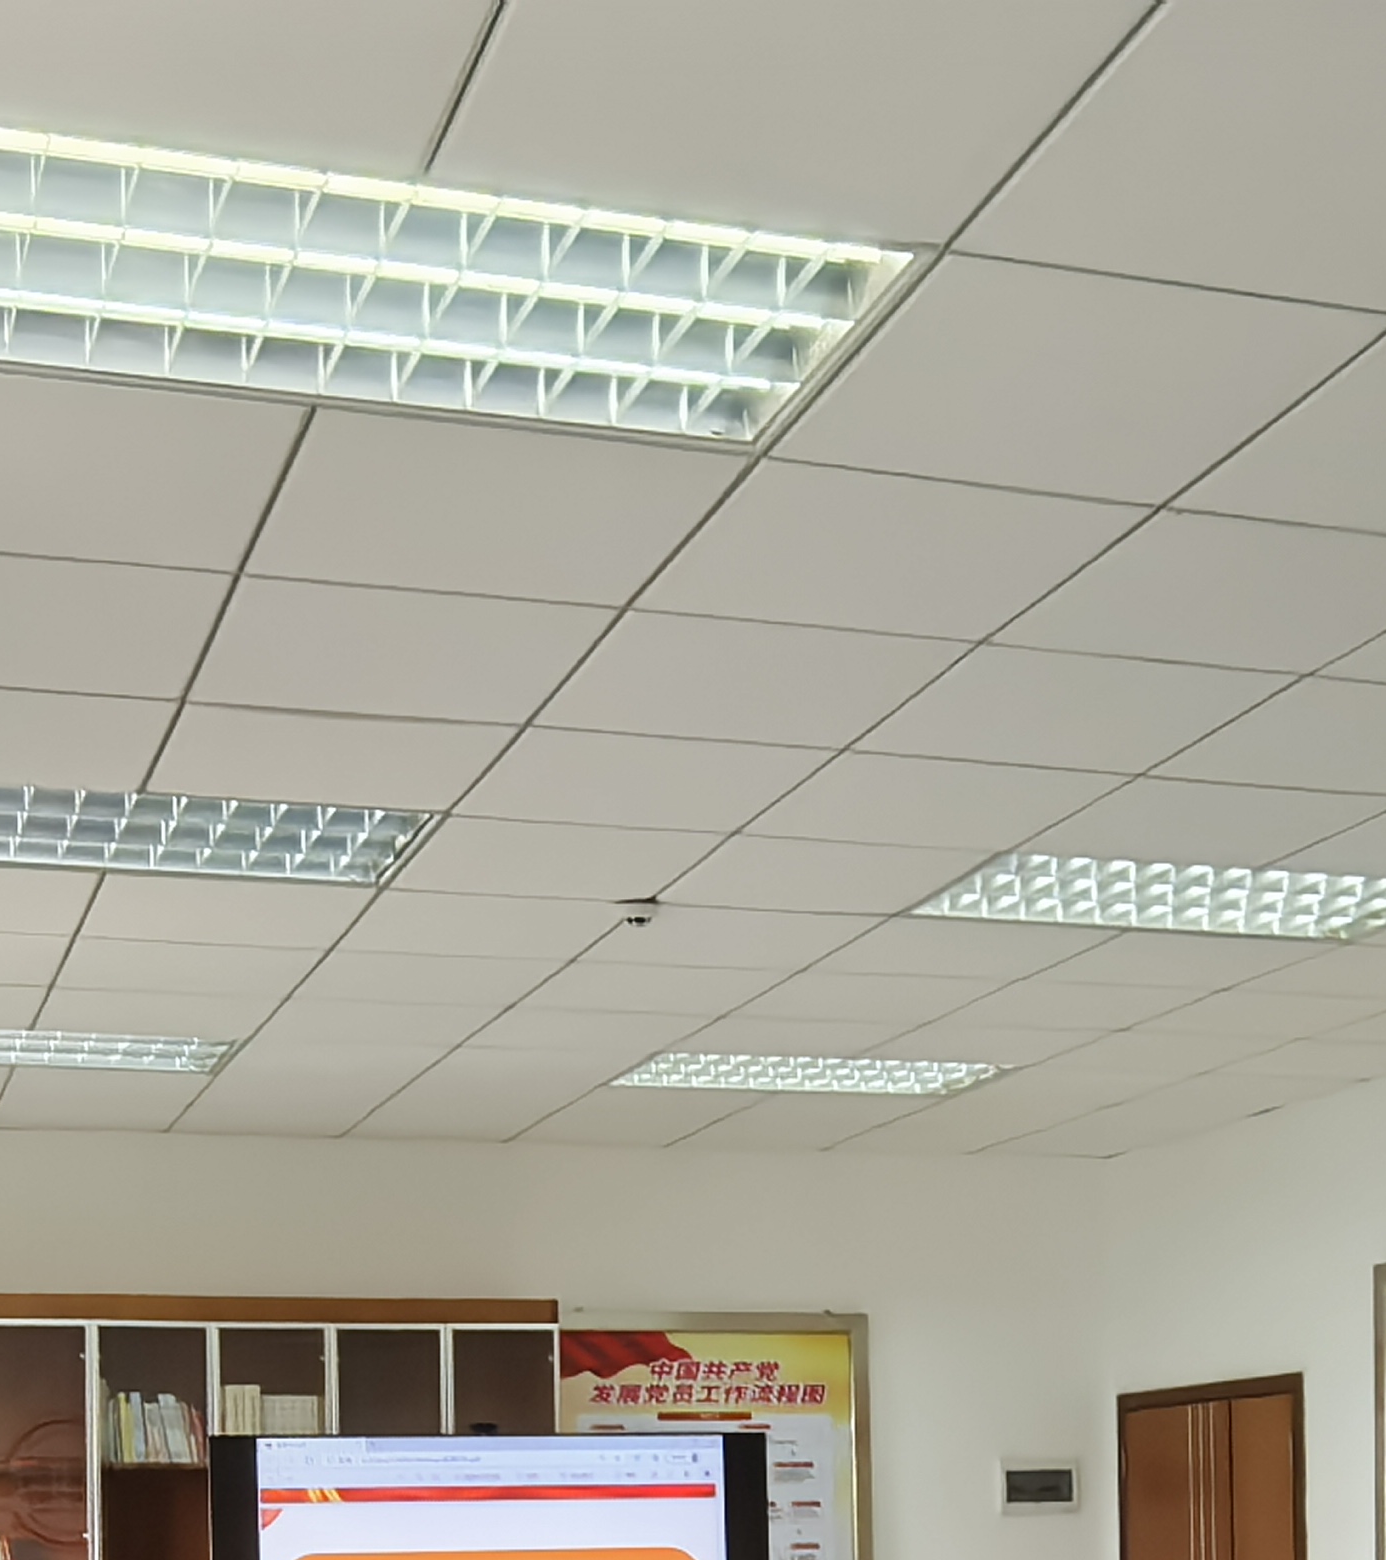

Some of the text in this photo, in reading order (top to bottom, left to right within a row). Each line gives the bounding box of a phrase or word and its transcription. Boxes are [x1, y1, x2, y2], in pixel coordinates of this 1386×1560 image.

[650, 1360, 780, 1382] 中国共产党
[592, 1383, 826, 1405] 发展党员工作流程图
